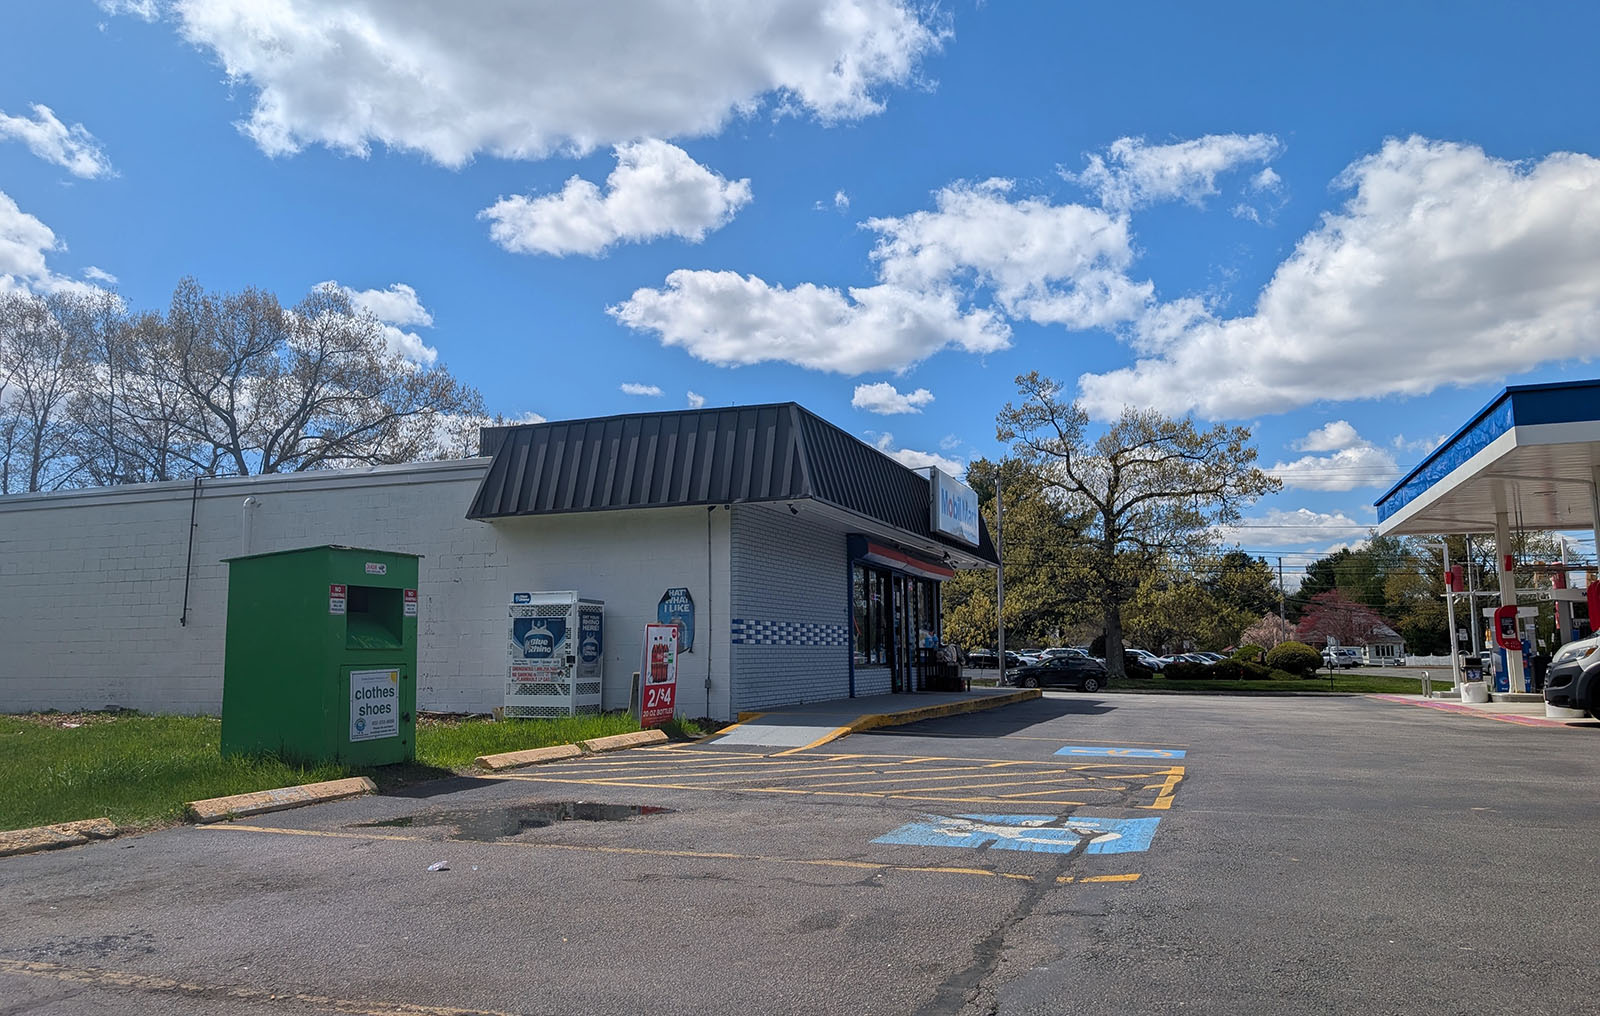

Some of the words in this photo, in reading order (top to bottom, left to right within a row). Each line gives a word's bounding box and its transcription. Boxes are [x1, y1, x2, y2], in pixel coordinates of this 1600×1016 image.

[941, 488, 961, 521] Mobil
[664, 604, 668, 613] I
[669, 604, 690, 612] LIKE
[355, 686, 395, 700] clothes
[648, 688, 671, 707] 2/$4
[359, 703, 392, 716] shoes
